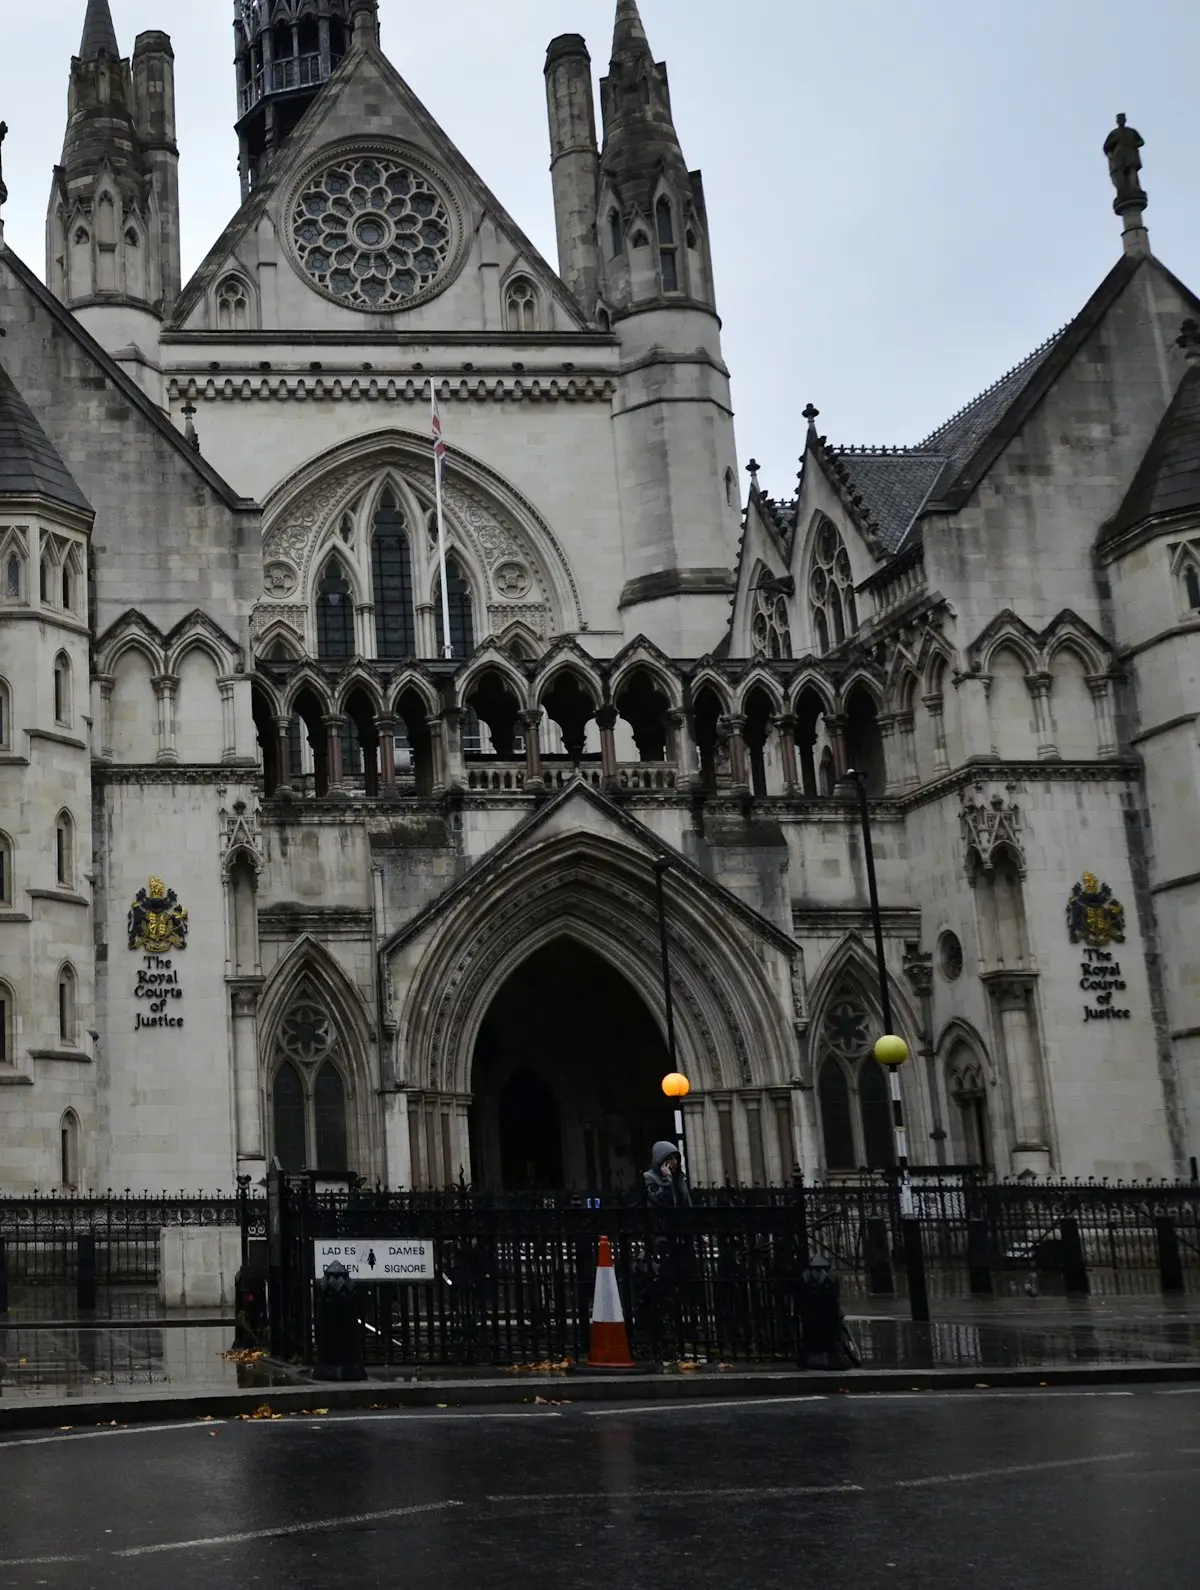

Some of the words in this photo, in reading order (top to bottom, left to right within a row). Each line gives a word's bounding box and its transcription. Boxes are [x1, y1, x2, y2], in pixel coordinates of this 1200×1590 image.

[143, 955, 172, 969] The
[1083, 948, 1113, 962] The
[1081, 962, 1120, 978] Royal
[137, 969, 178, 986] Royal
[1079, 977, 1127, 991] Courts
[134, 984, 183, 999] Courts
[1096, 991, 1113, 1005] of
[150, 998, 167, 1013] of
[1083, 1005, 1131, 1023] Justice
[134, 1013, 184, 1031] Justice
[388, 1246, 425, 1256] DAMES
[322, 1264, 359, 1273] DEN
[384, 1264, 427, 1273] SIGNORE
